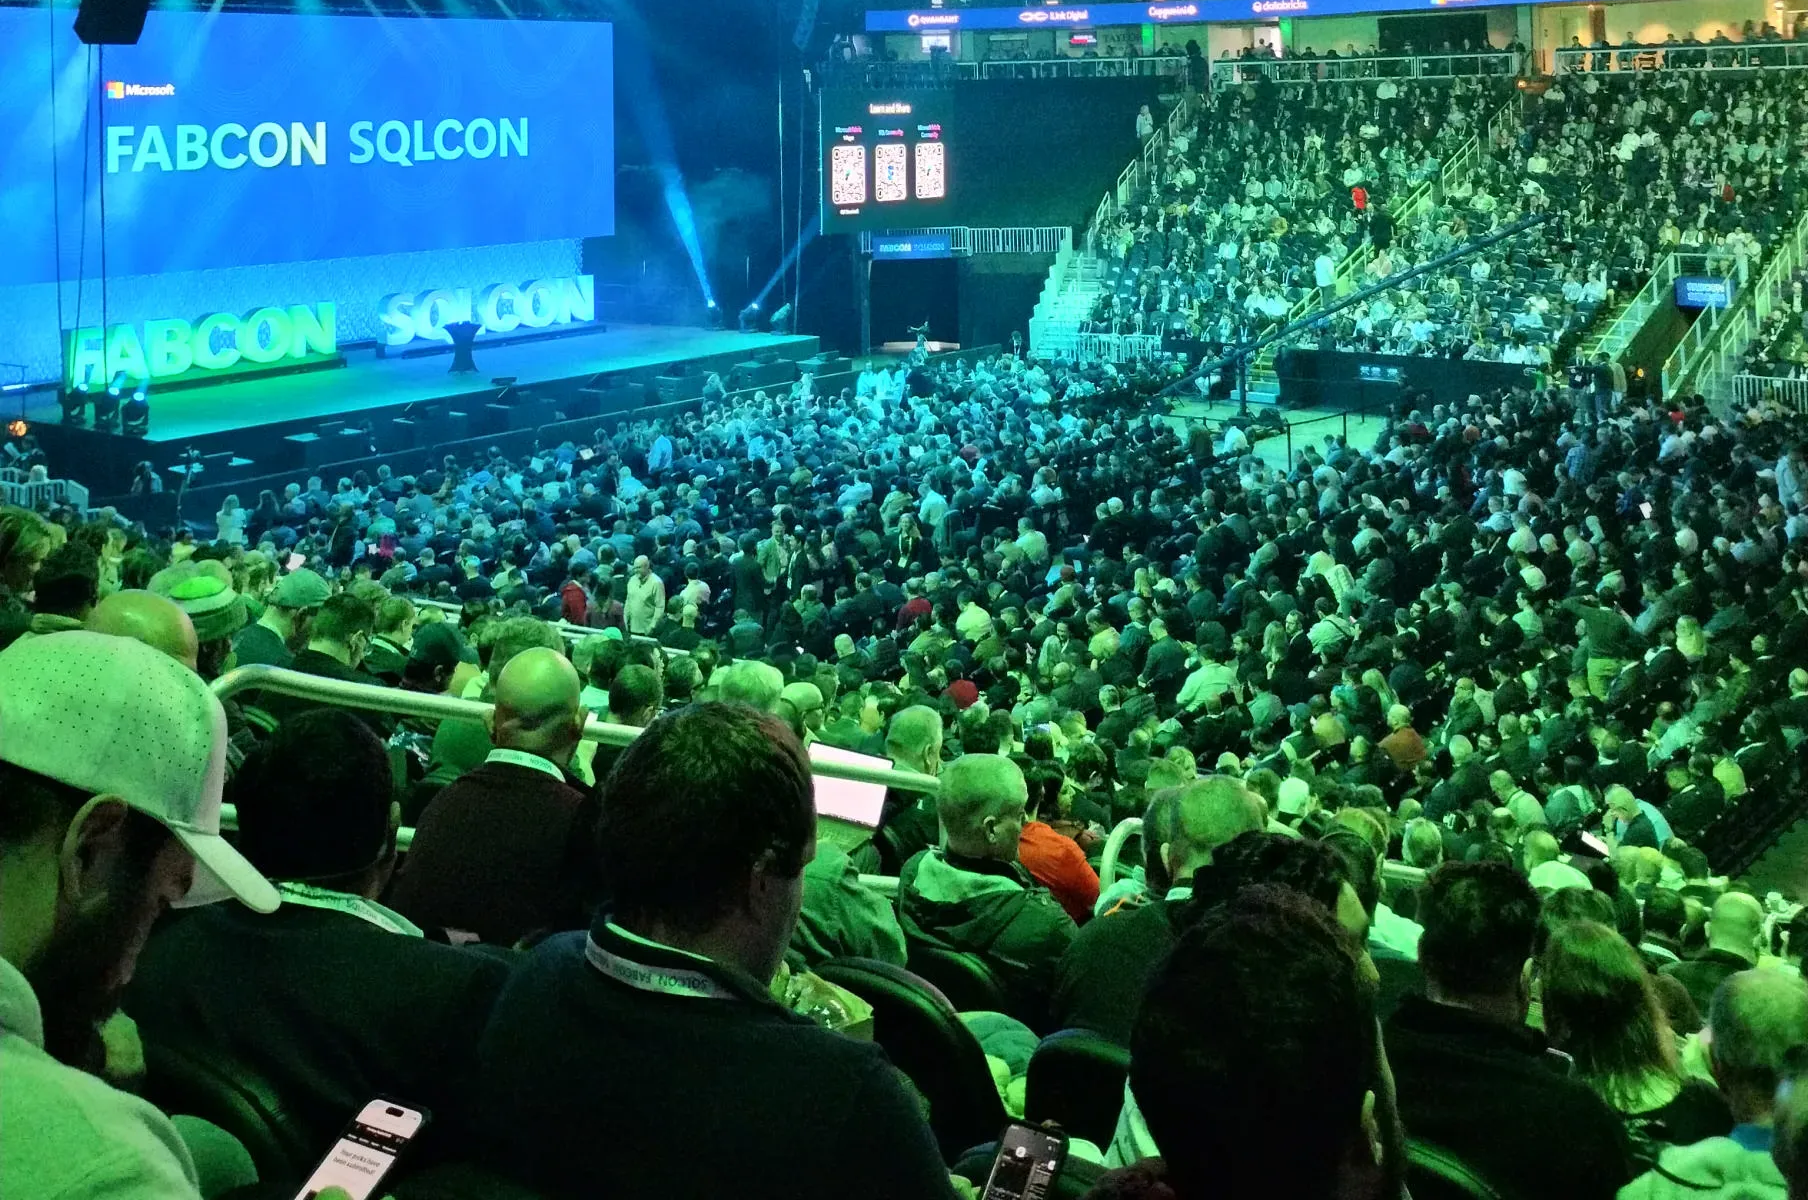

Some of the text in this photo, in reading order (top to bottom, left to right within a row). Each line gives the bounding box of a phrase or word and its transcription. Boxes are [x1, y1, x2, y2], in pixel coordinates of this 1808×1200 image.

[126, 84, 175, 96] Microsoft
[107, 117, 528, 173] FABCON SQLCON
[379, 274, 595, 346] SQLCON
[68, 301, 337, 386] FABCON
